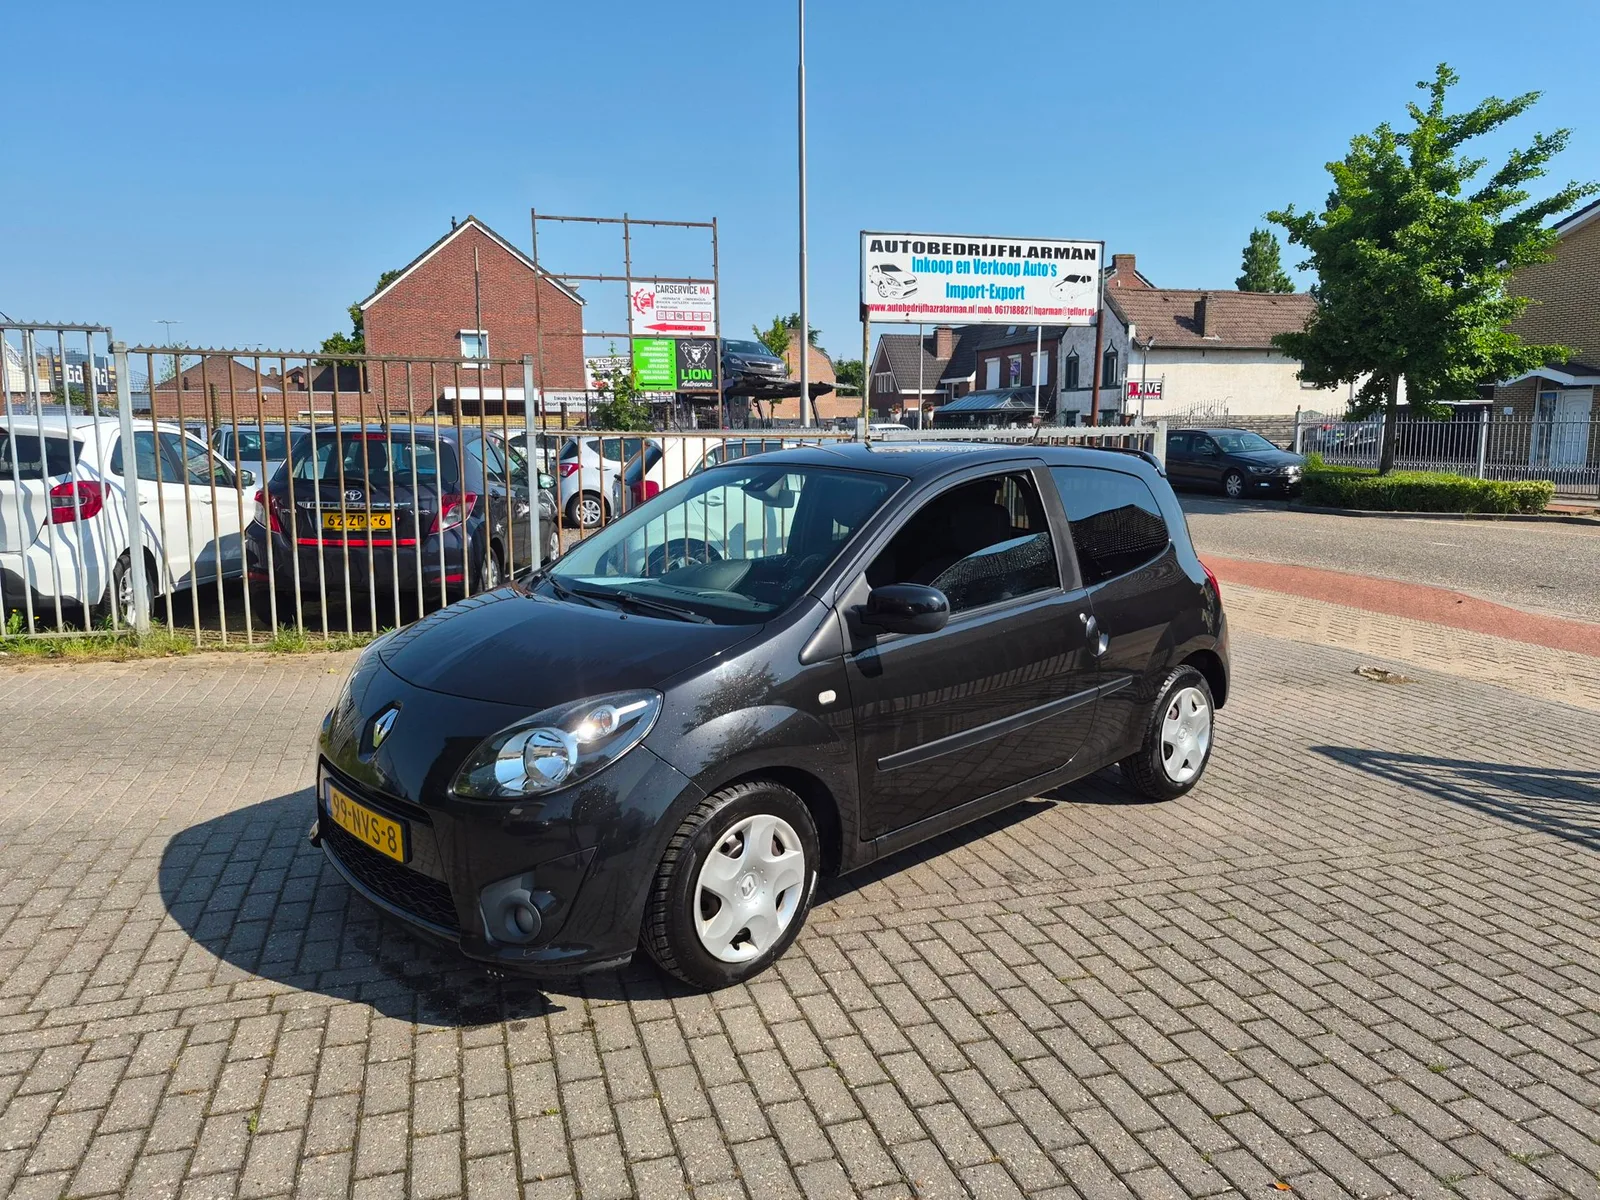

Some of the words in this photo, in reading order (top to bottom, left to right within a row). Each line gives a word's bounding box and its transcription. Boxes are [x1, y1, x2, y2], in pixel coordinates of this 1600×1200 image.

[912, 256, 953, 275] Inkoop
[956, 261, 971, 274] en
[973, 259, 1021, 278] Verkoop
[1023, 261, 1057, 277] Auto's
[655, 285, 698, 294] CARSERVICE
[700, 286, 710, 295] MA
[945, 282, 1025, 301] Import-Export
[681, 369, 712, 380] LION
[681, 380, 713, 388] Autoservice
[333, 793, 397, 853] 99-NVS-8
